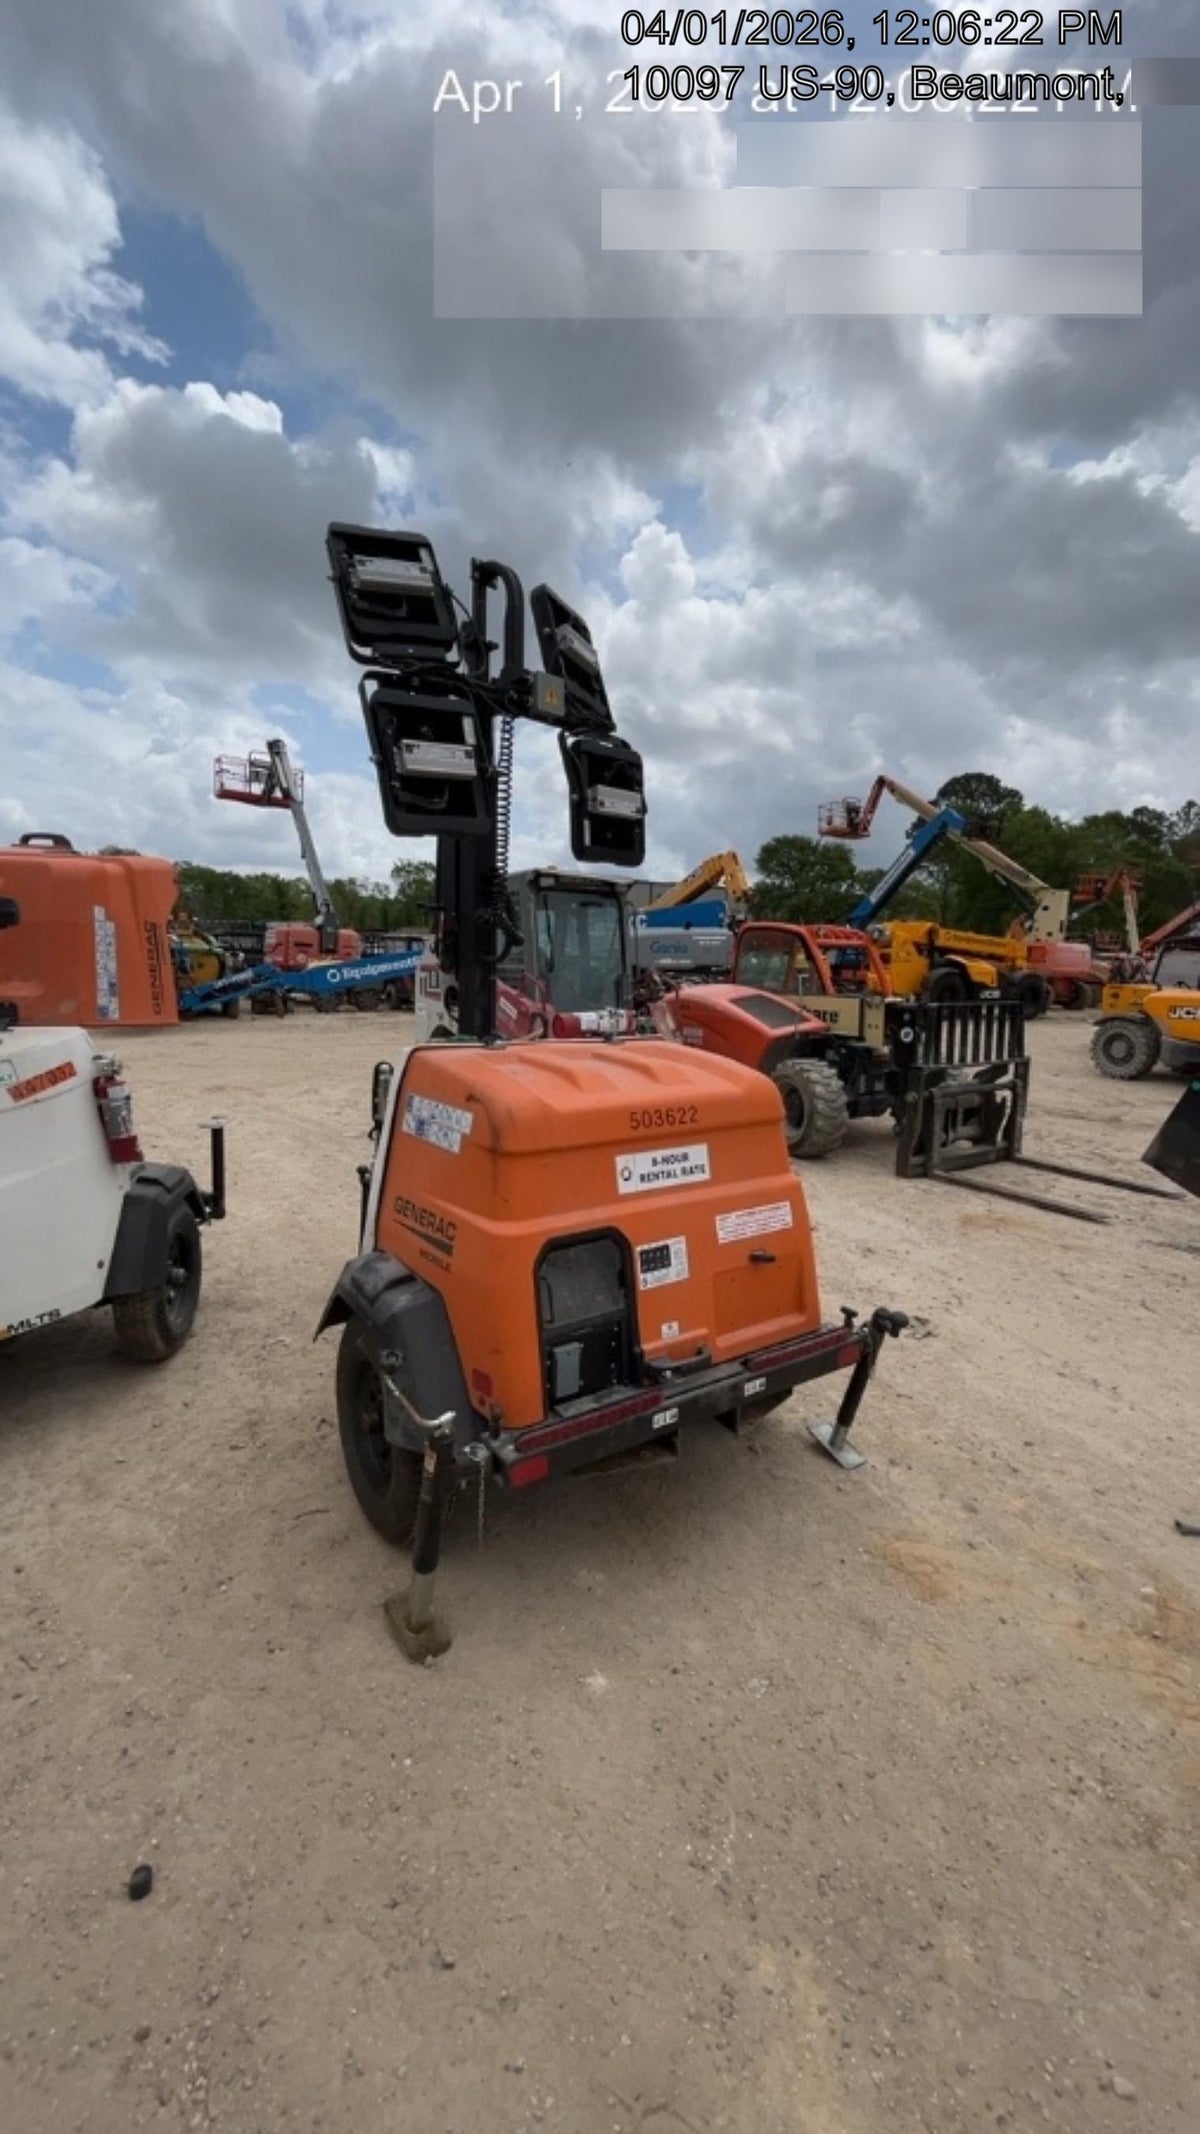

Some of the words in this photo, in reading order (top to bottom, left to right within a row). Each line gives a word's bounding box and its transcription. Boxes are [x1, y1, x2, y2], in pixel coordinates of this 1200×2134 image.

[801, 1004, 839, 1023] are
[1168, 1006, 1200, 1018] JC
[629, 1104, 699, 1131] 503622
[639, 1167, 680, 1184] RENTAL
[680, 1162, 706, 1177] RATE
[394, 1196, 458, 1241] GENERAC
